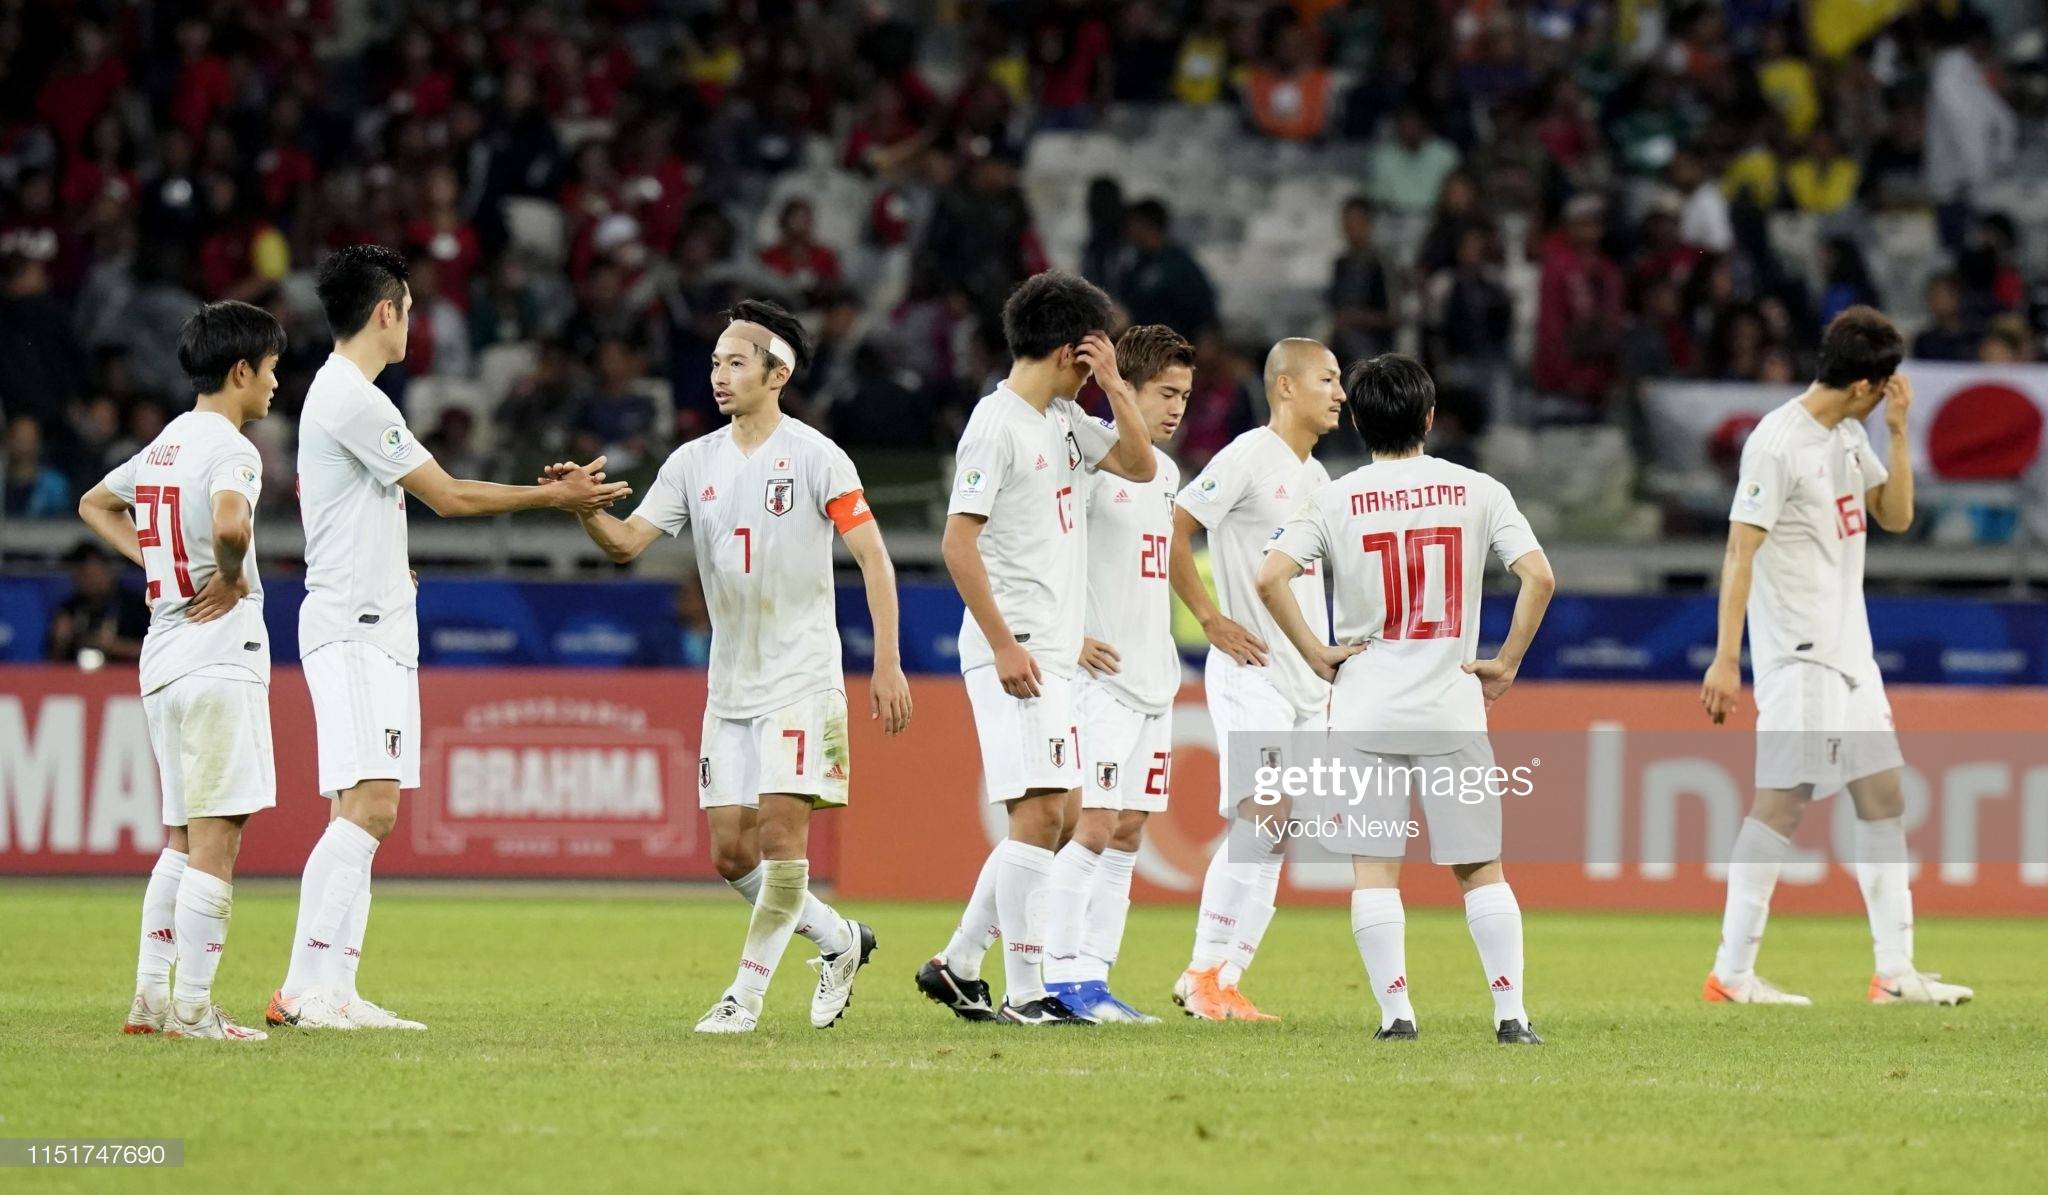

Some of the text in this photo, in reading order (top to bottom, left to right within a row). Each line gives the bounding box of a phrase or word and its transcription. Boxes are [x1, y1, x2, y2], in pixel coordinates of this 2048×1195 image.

[147, 445, 181, 466] KUBO
[1352, 485, 1466, 515] NAKAJIMA
[136, 485, 197, 598] 21
[734, 528, 750, 574] 7
[1141, 534, 1167, 579] 20
[1362, 526, 1462, 640] 10
[782, 730, 805, 776] 7
[446, 746, 664, 819] BRAHMA
